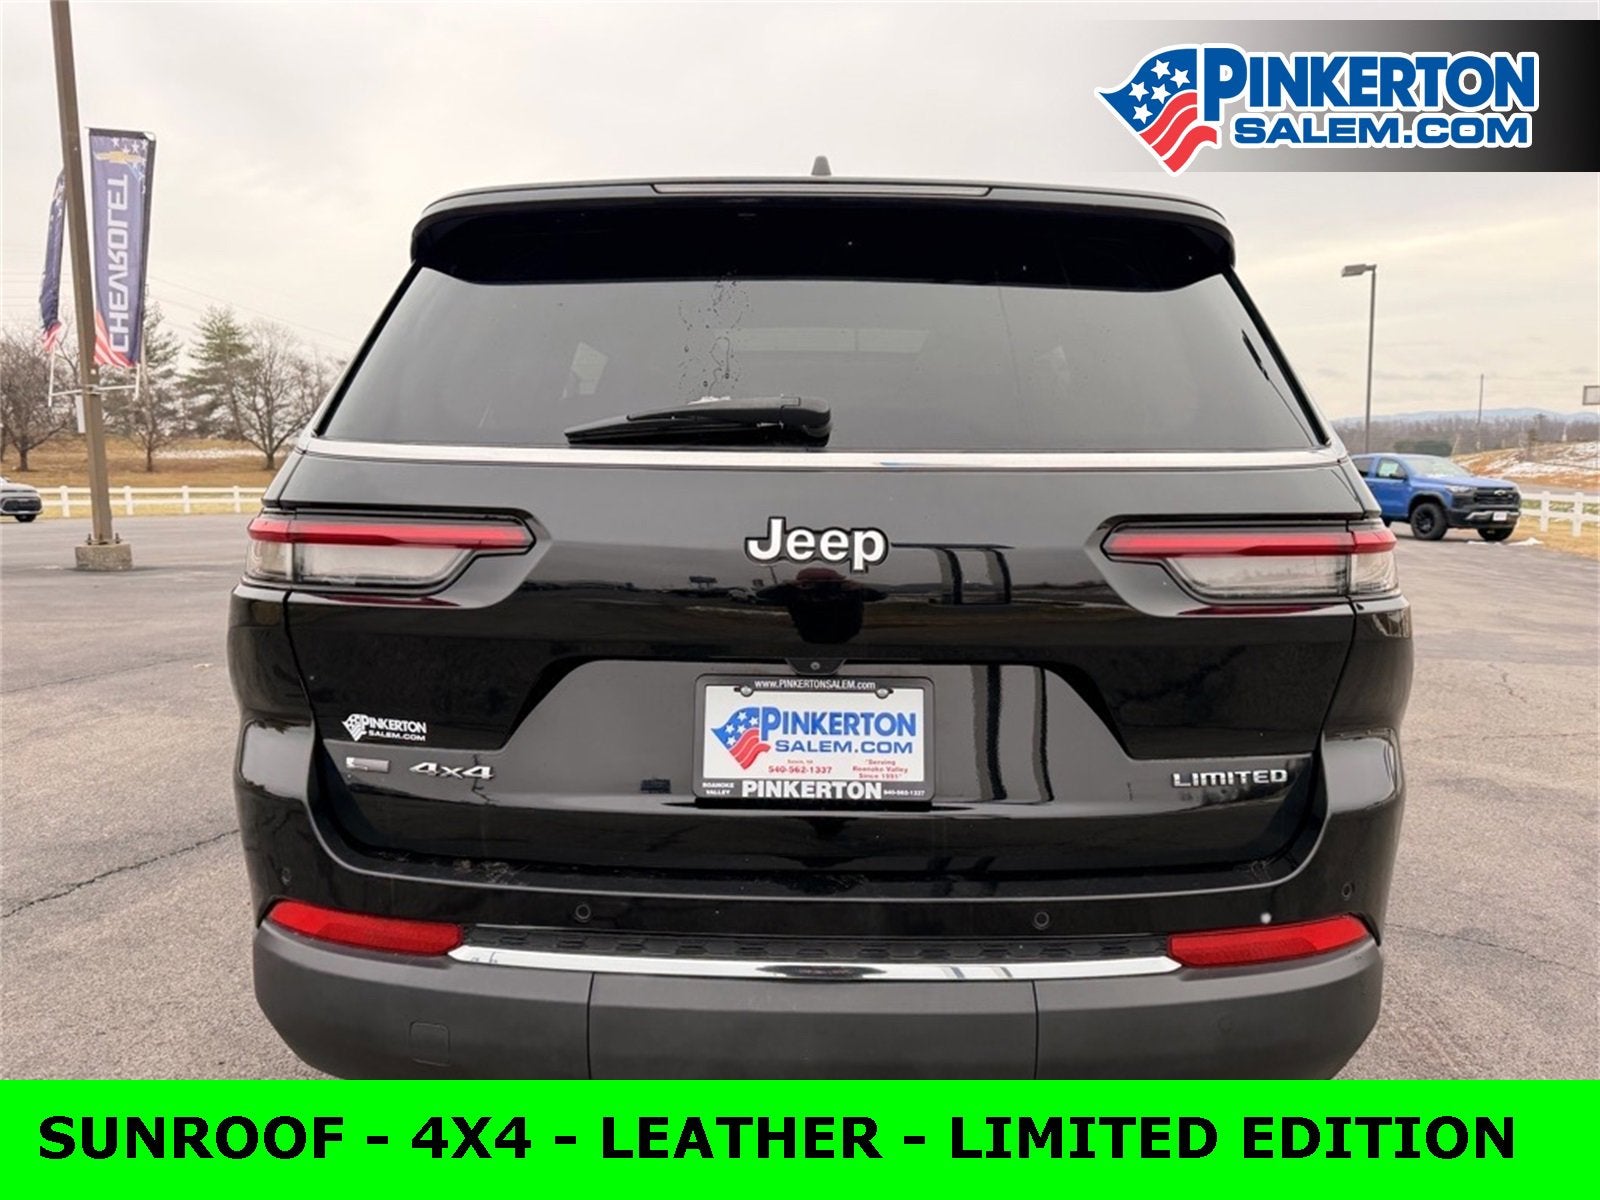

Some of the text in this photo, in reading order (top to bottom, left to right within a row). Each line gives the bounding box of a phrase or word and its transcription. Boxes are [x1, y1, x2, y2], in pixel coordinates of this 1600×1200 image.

[747, 518, 885, 570] Jeep
[754, 679, 876, 690] www.PINKERTONSALEM.com
[361, 714, 427, 734] PINKERTON
[761, 706, 916, 741] PINKERTON
[368, 729, 426, 742] SALEM.COM
[775, 740, 913, 754] SALEM.COM
[768, 765, 832, 774] 540-562-1337
[1173, 769, 1288, 787] LIMITED
[742, 780, 882, 800] PINKERTON
